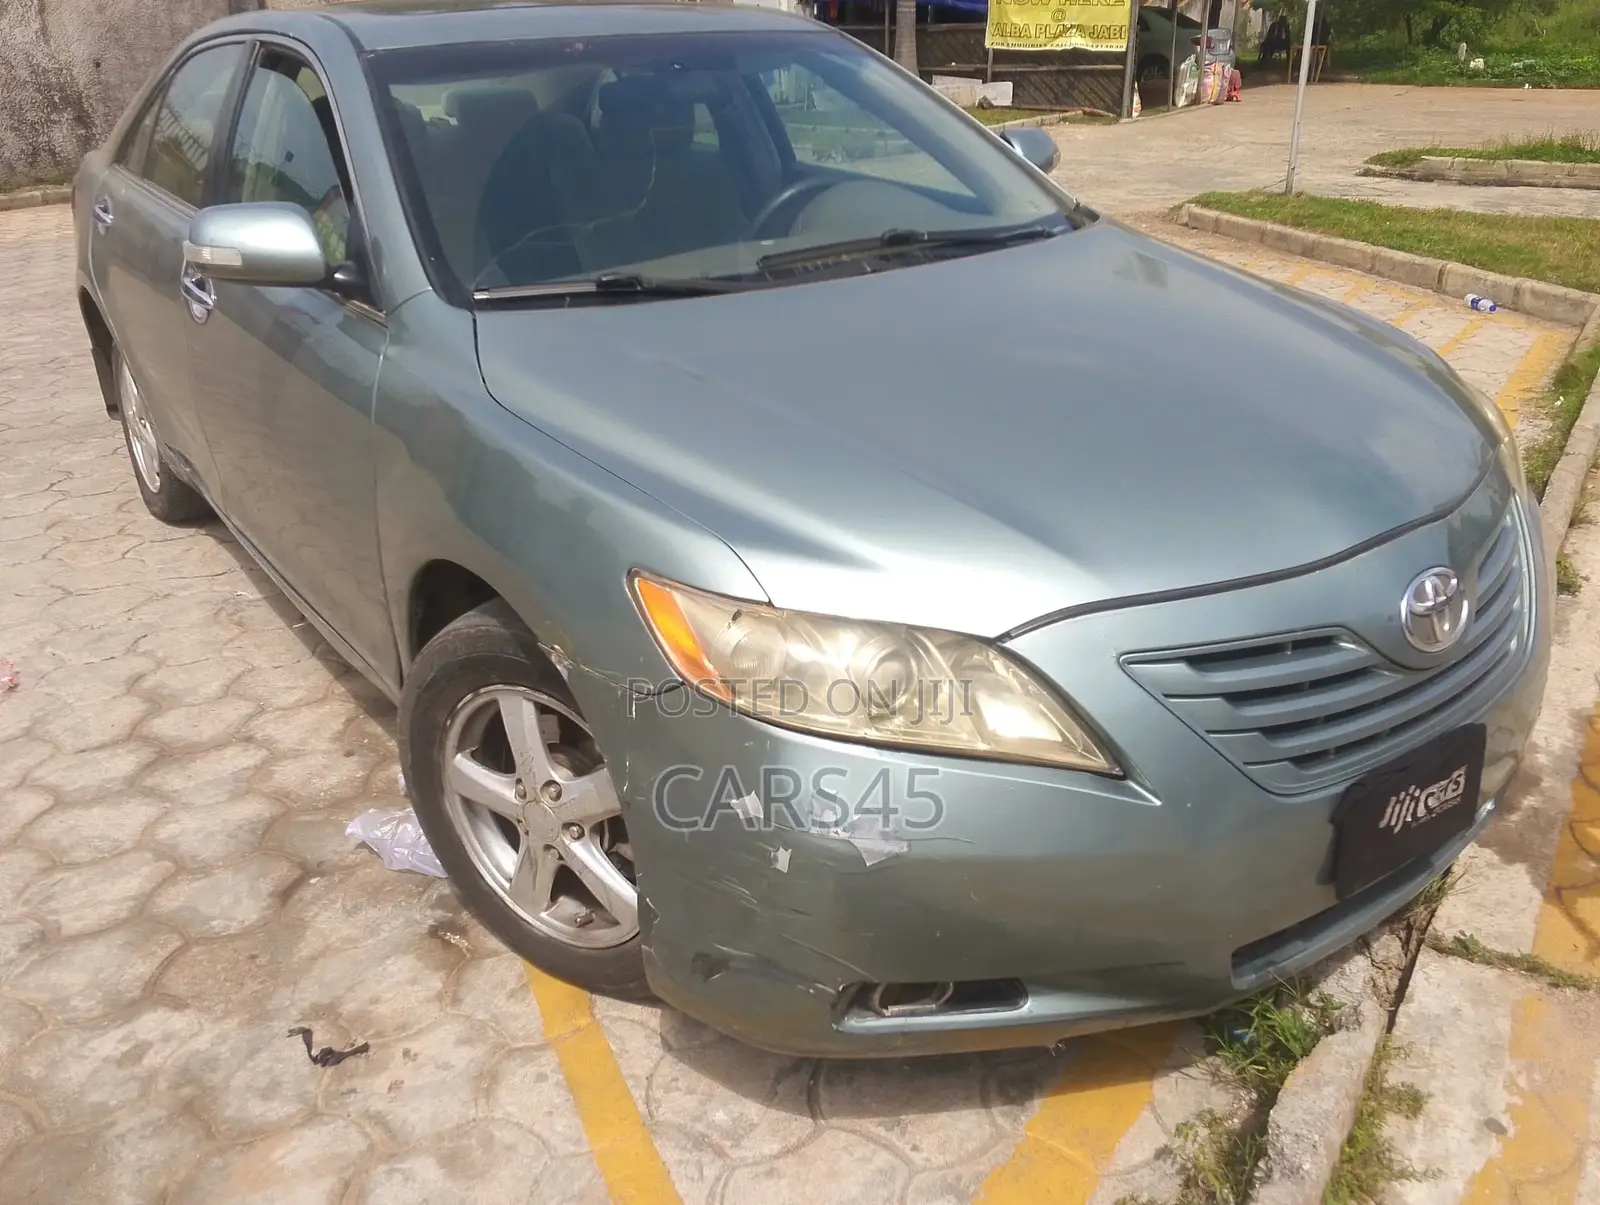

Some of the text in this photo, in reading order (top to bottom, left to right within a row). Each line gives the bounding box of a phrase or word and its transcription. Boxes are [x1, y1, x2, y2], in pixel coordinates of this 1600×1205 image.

[1051, 8, 1066, 23] @
[1035, 23, 1087, 39] PLAZA
[1089, 24, 1127, 40] JABI
